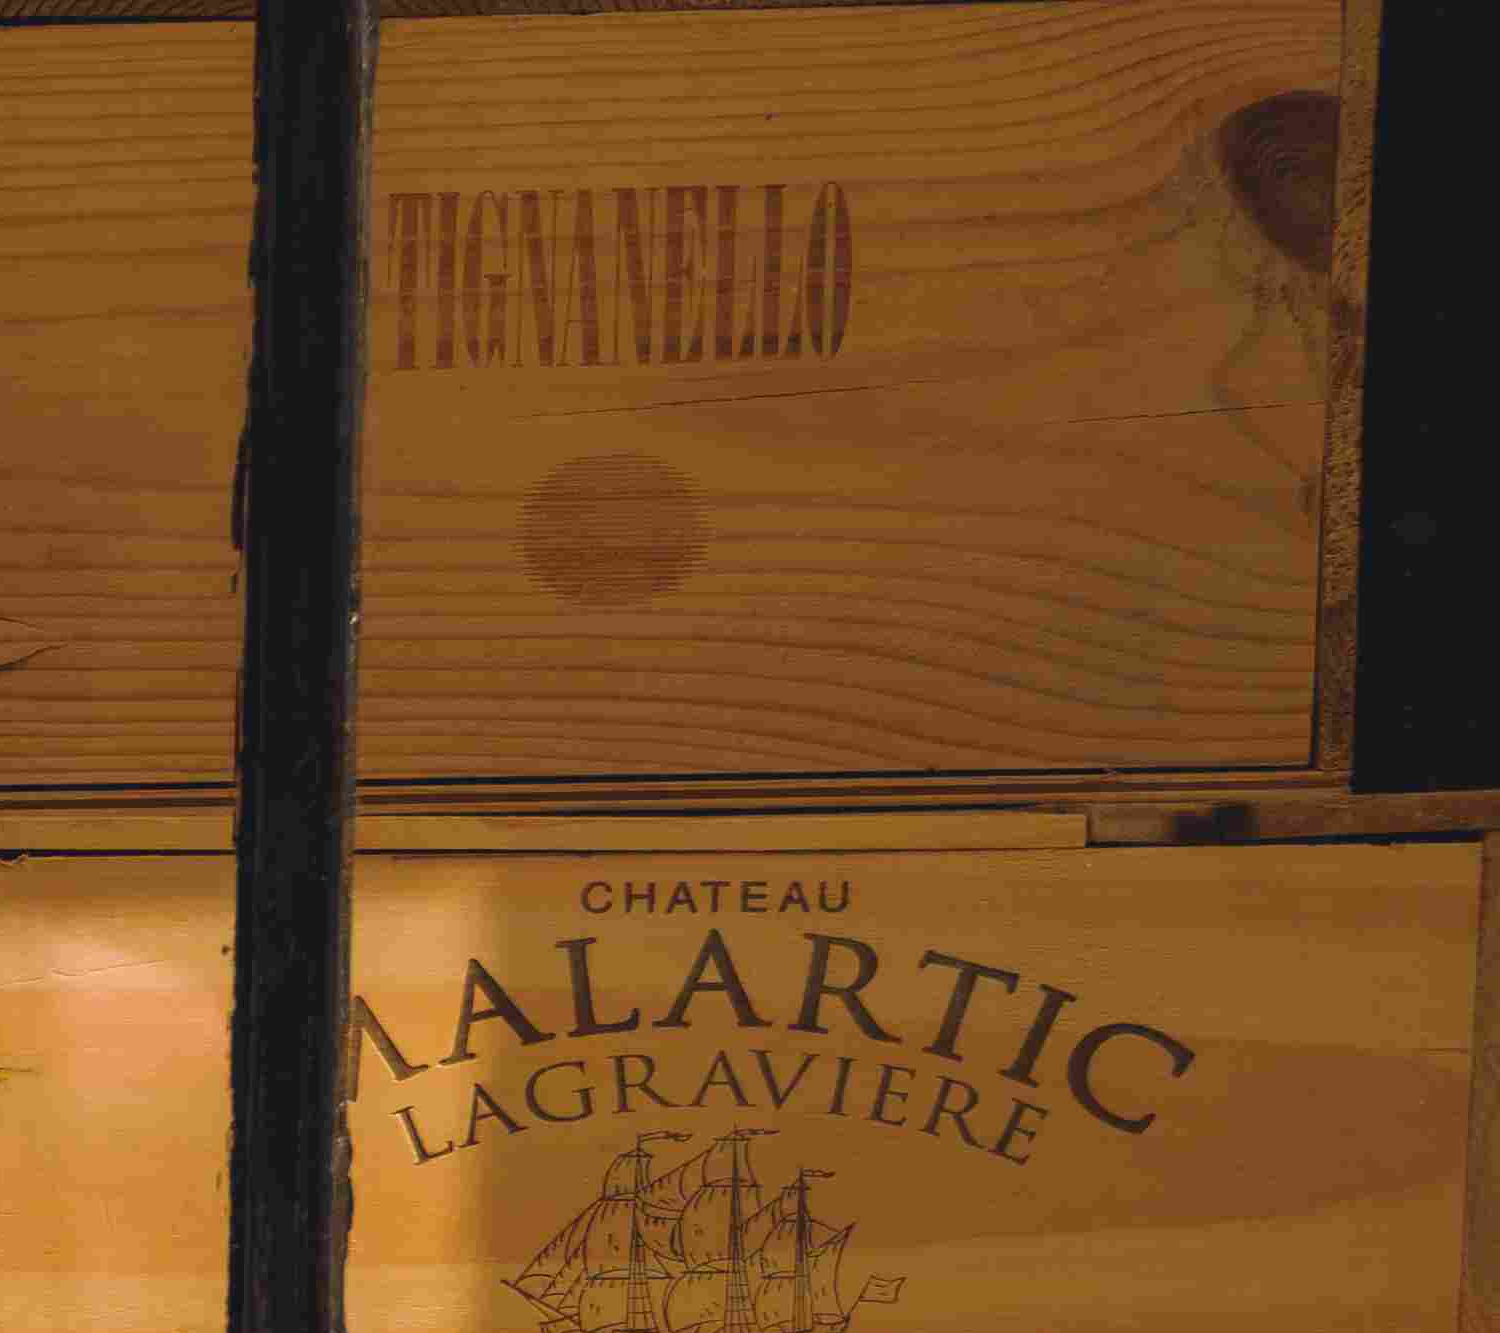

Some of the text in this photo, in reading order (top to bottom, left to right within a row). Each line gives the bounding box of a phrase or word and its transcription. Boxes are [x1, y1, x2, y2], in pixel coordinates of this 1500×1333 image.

[389, 178, 853, 372] TIGNANELLO
[579, 879, 852, 916] CHATEAU
[392, 1048, 1050, 1166] LAGRAVIERE
